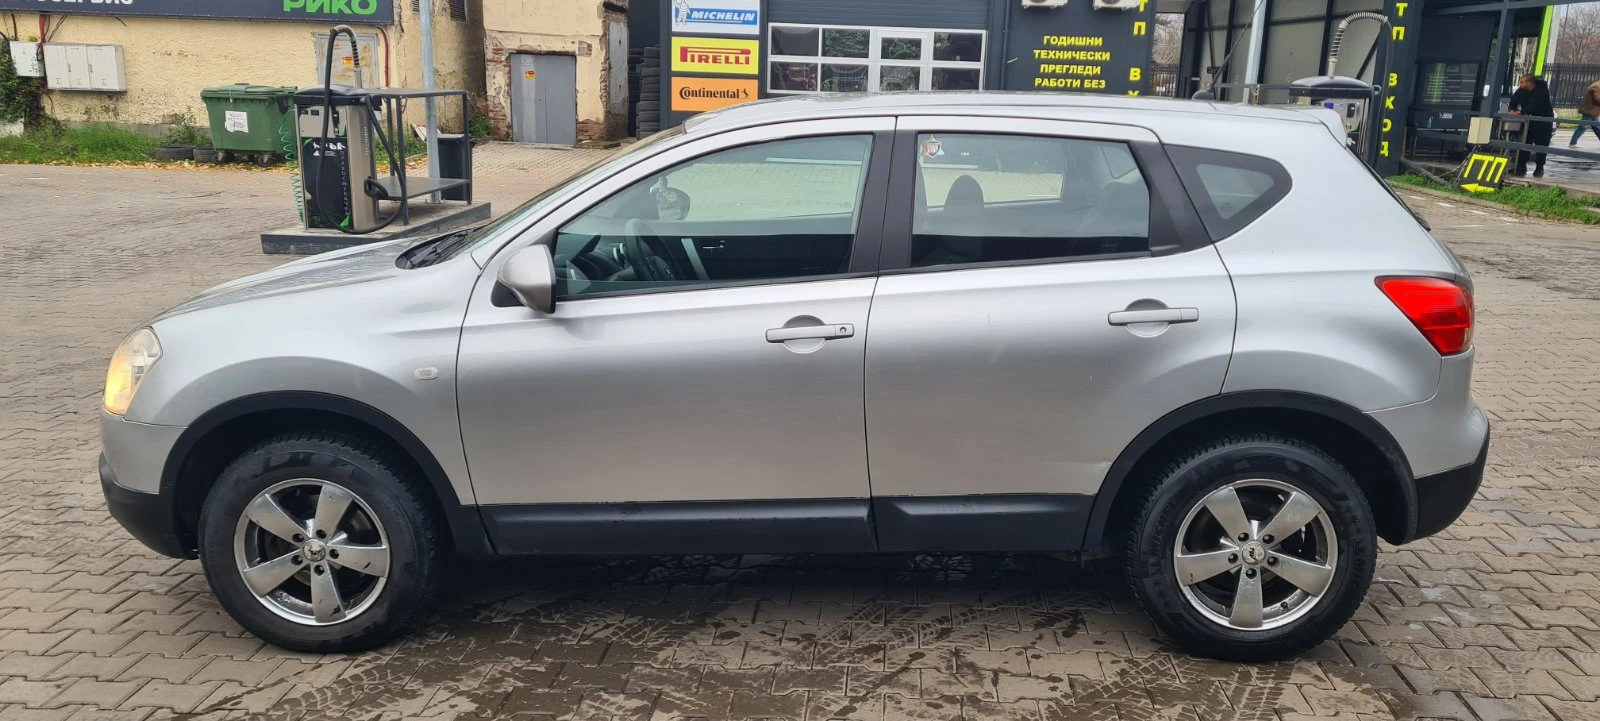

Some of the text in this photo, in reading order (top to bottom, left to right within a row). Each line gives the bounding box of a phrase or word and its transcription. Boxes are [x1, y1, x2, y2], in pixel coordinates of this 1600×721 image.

[691, 10, 755, 21] MICHELIN
[1043, 35, 1103, 47] ГОДИШНИ
[680, 46, 751, 65] PIRELLI
[1033, 49, 1111, 60] ТЕХНИЧЕСКИ
[1040, 64, 1101, 75] ПРЕГЛЕДИ
[1034, 78, 1106, 89] РАБОТИ БЕЗ
[679, 86, 740, 100] Continental
[1463, 153, 1508, 184] ГТП
